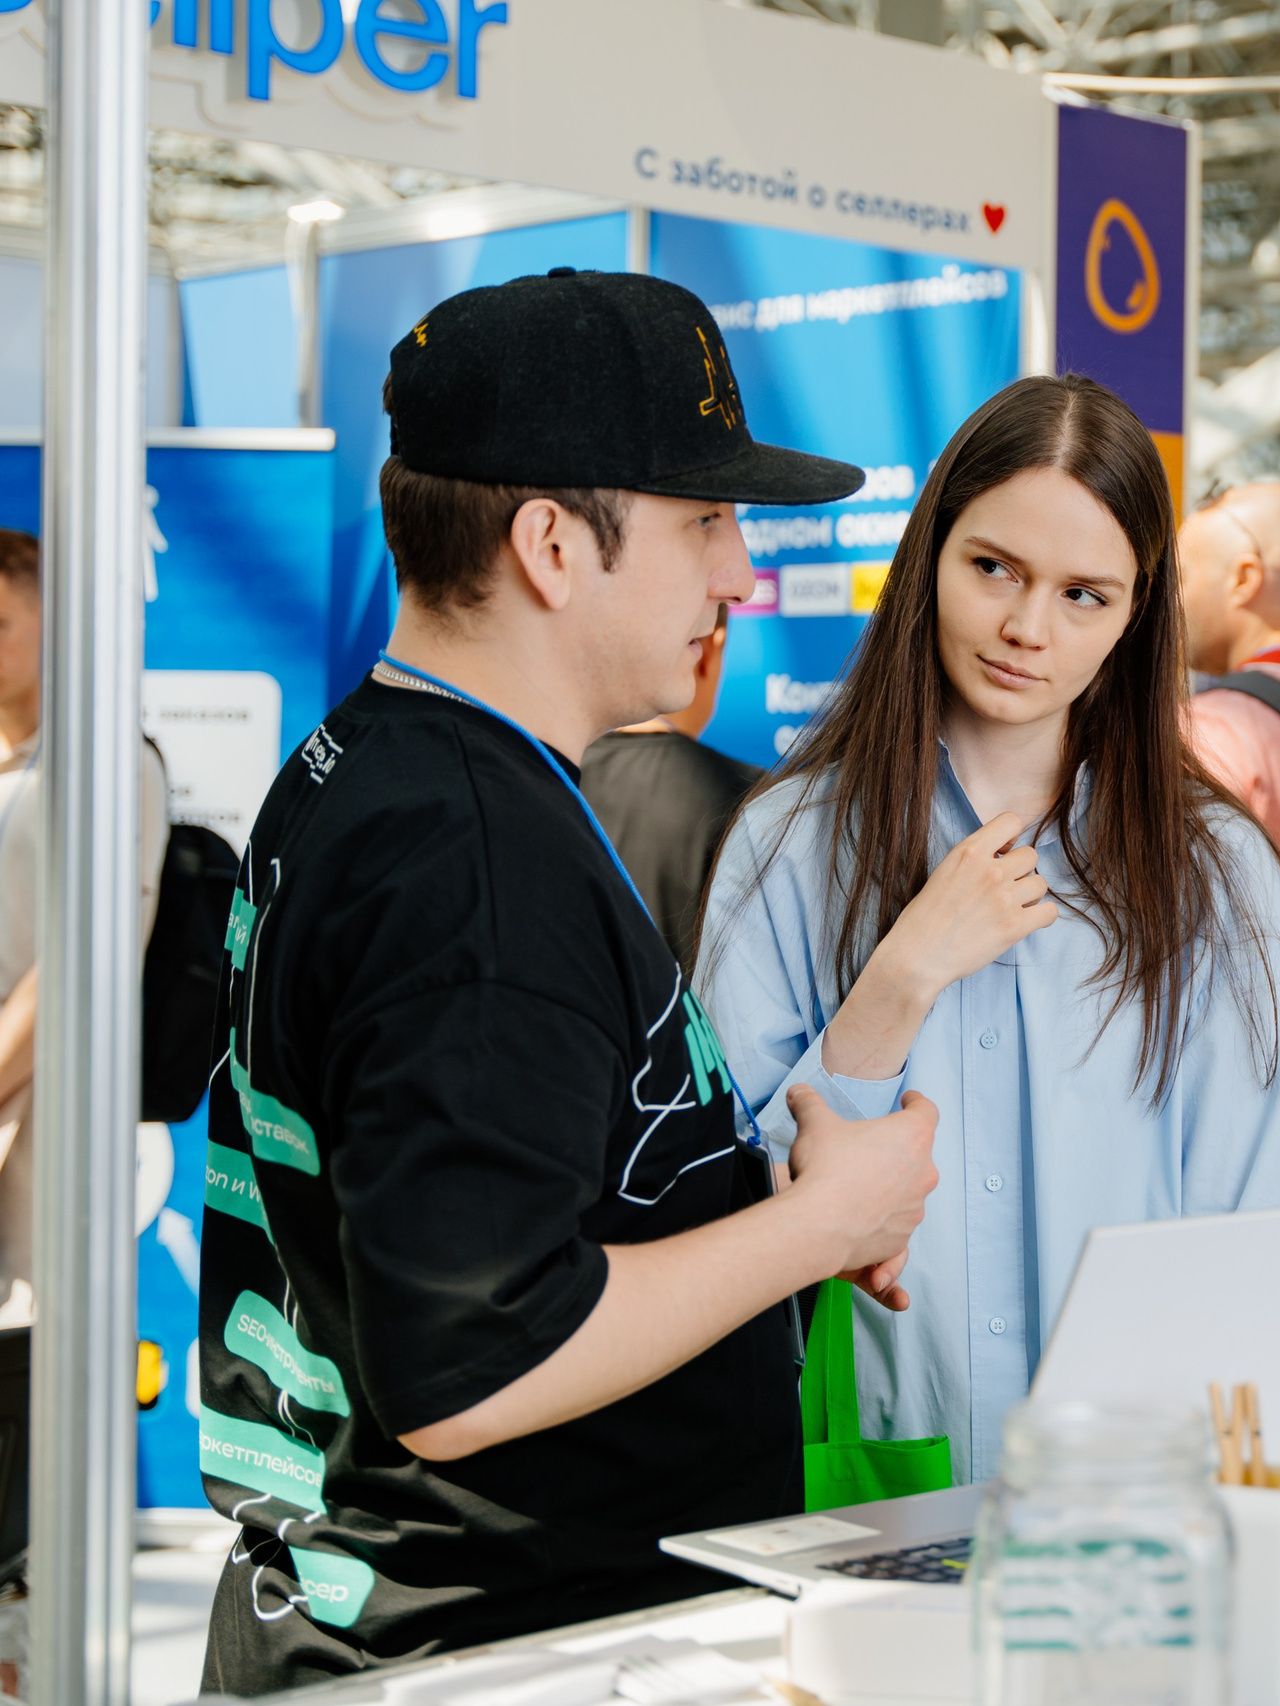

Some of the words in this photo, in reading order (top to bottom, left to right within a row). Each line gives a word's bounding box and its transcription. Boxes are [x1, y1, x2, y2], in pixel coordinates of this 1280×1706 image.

[635, 146, 659, 180] С
[671, 157, 800, 202] заботой
[808, 184, 827, 209] о
[836, 189, 970, 234] селлерах
